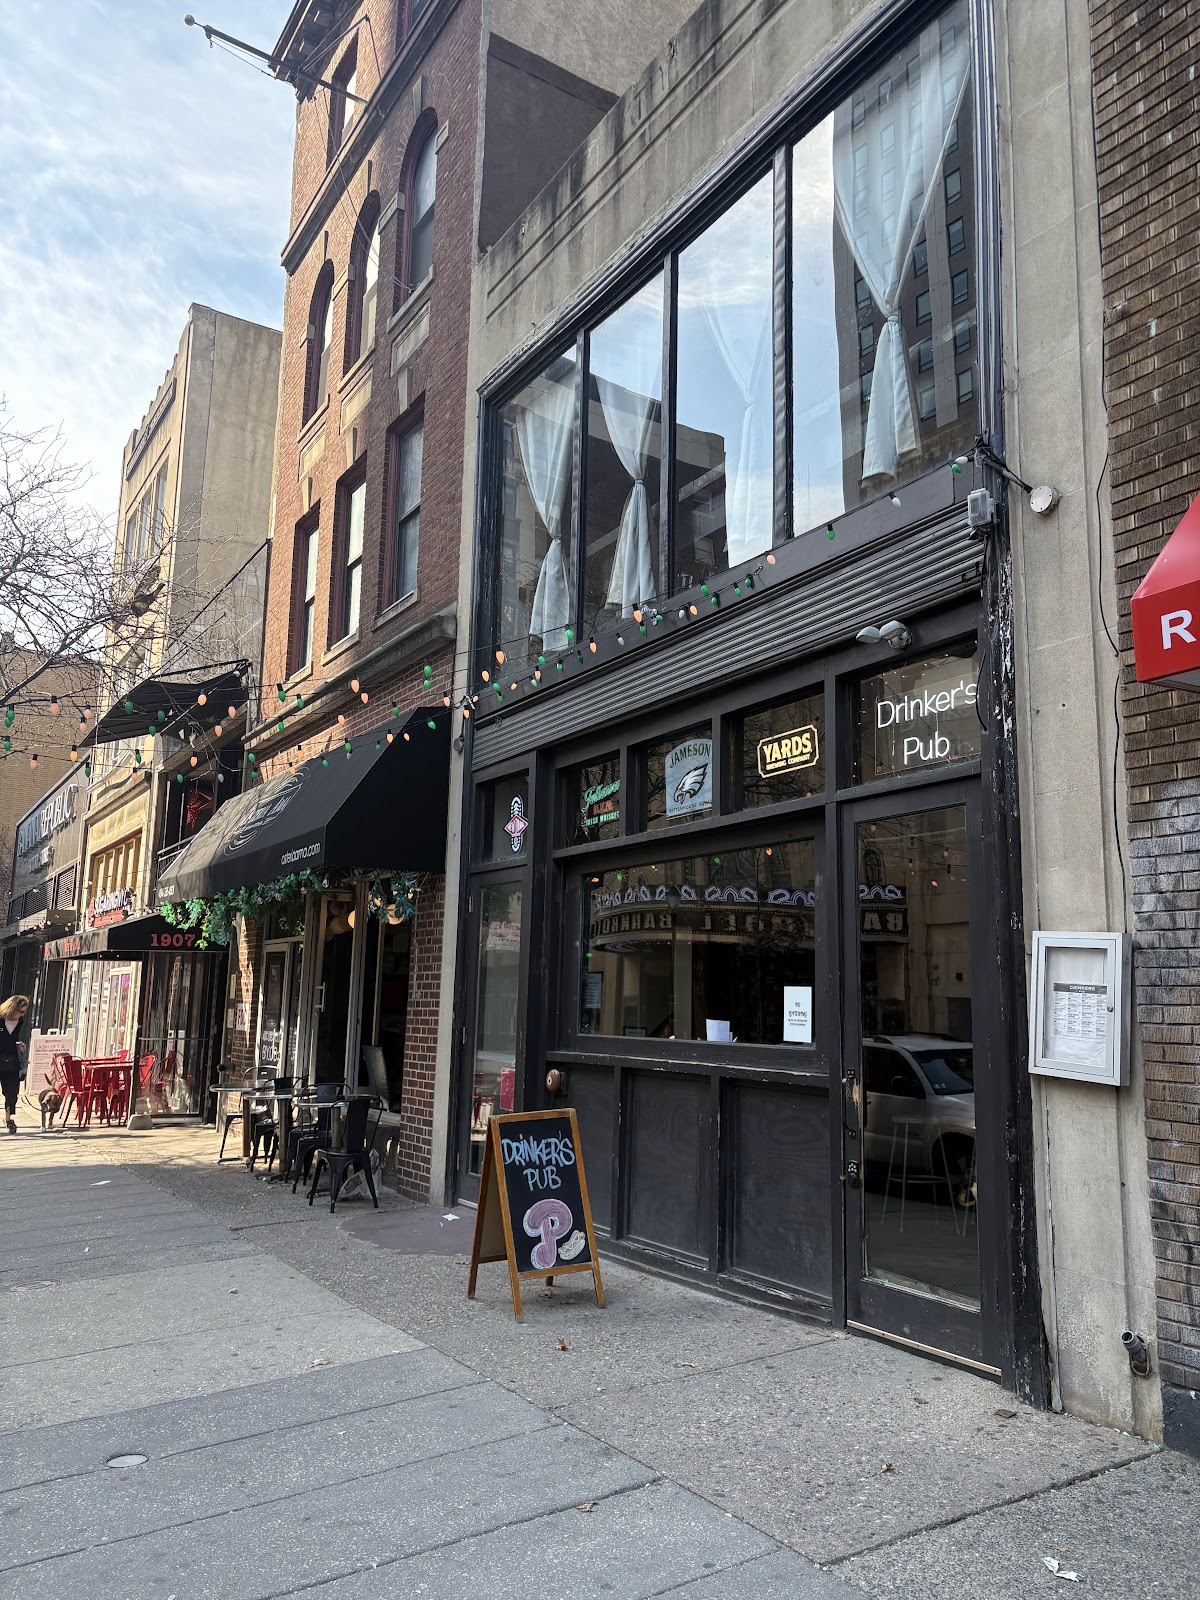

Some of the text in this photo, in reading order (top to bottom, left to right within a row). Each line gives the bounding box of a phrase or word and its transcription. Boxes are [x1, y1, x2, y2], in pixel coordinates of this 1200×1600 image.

[1161, 609, 1197, 650] R
[877, 680, 978, 728] Drinker's
[669, 743, 712, 769] JAMESON
[763, 733, 812, 763] YARDS
[788, 754, 811, 765] COMPANY
[903, 731, 950, 765] Pub
[151, 933, 195, 947] 1907
[523, 1166, 562, 1191] PUB
